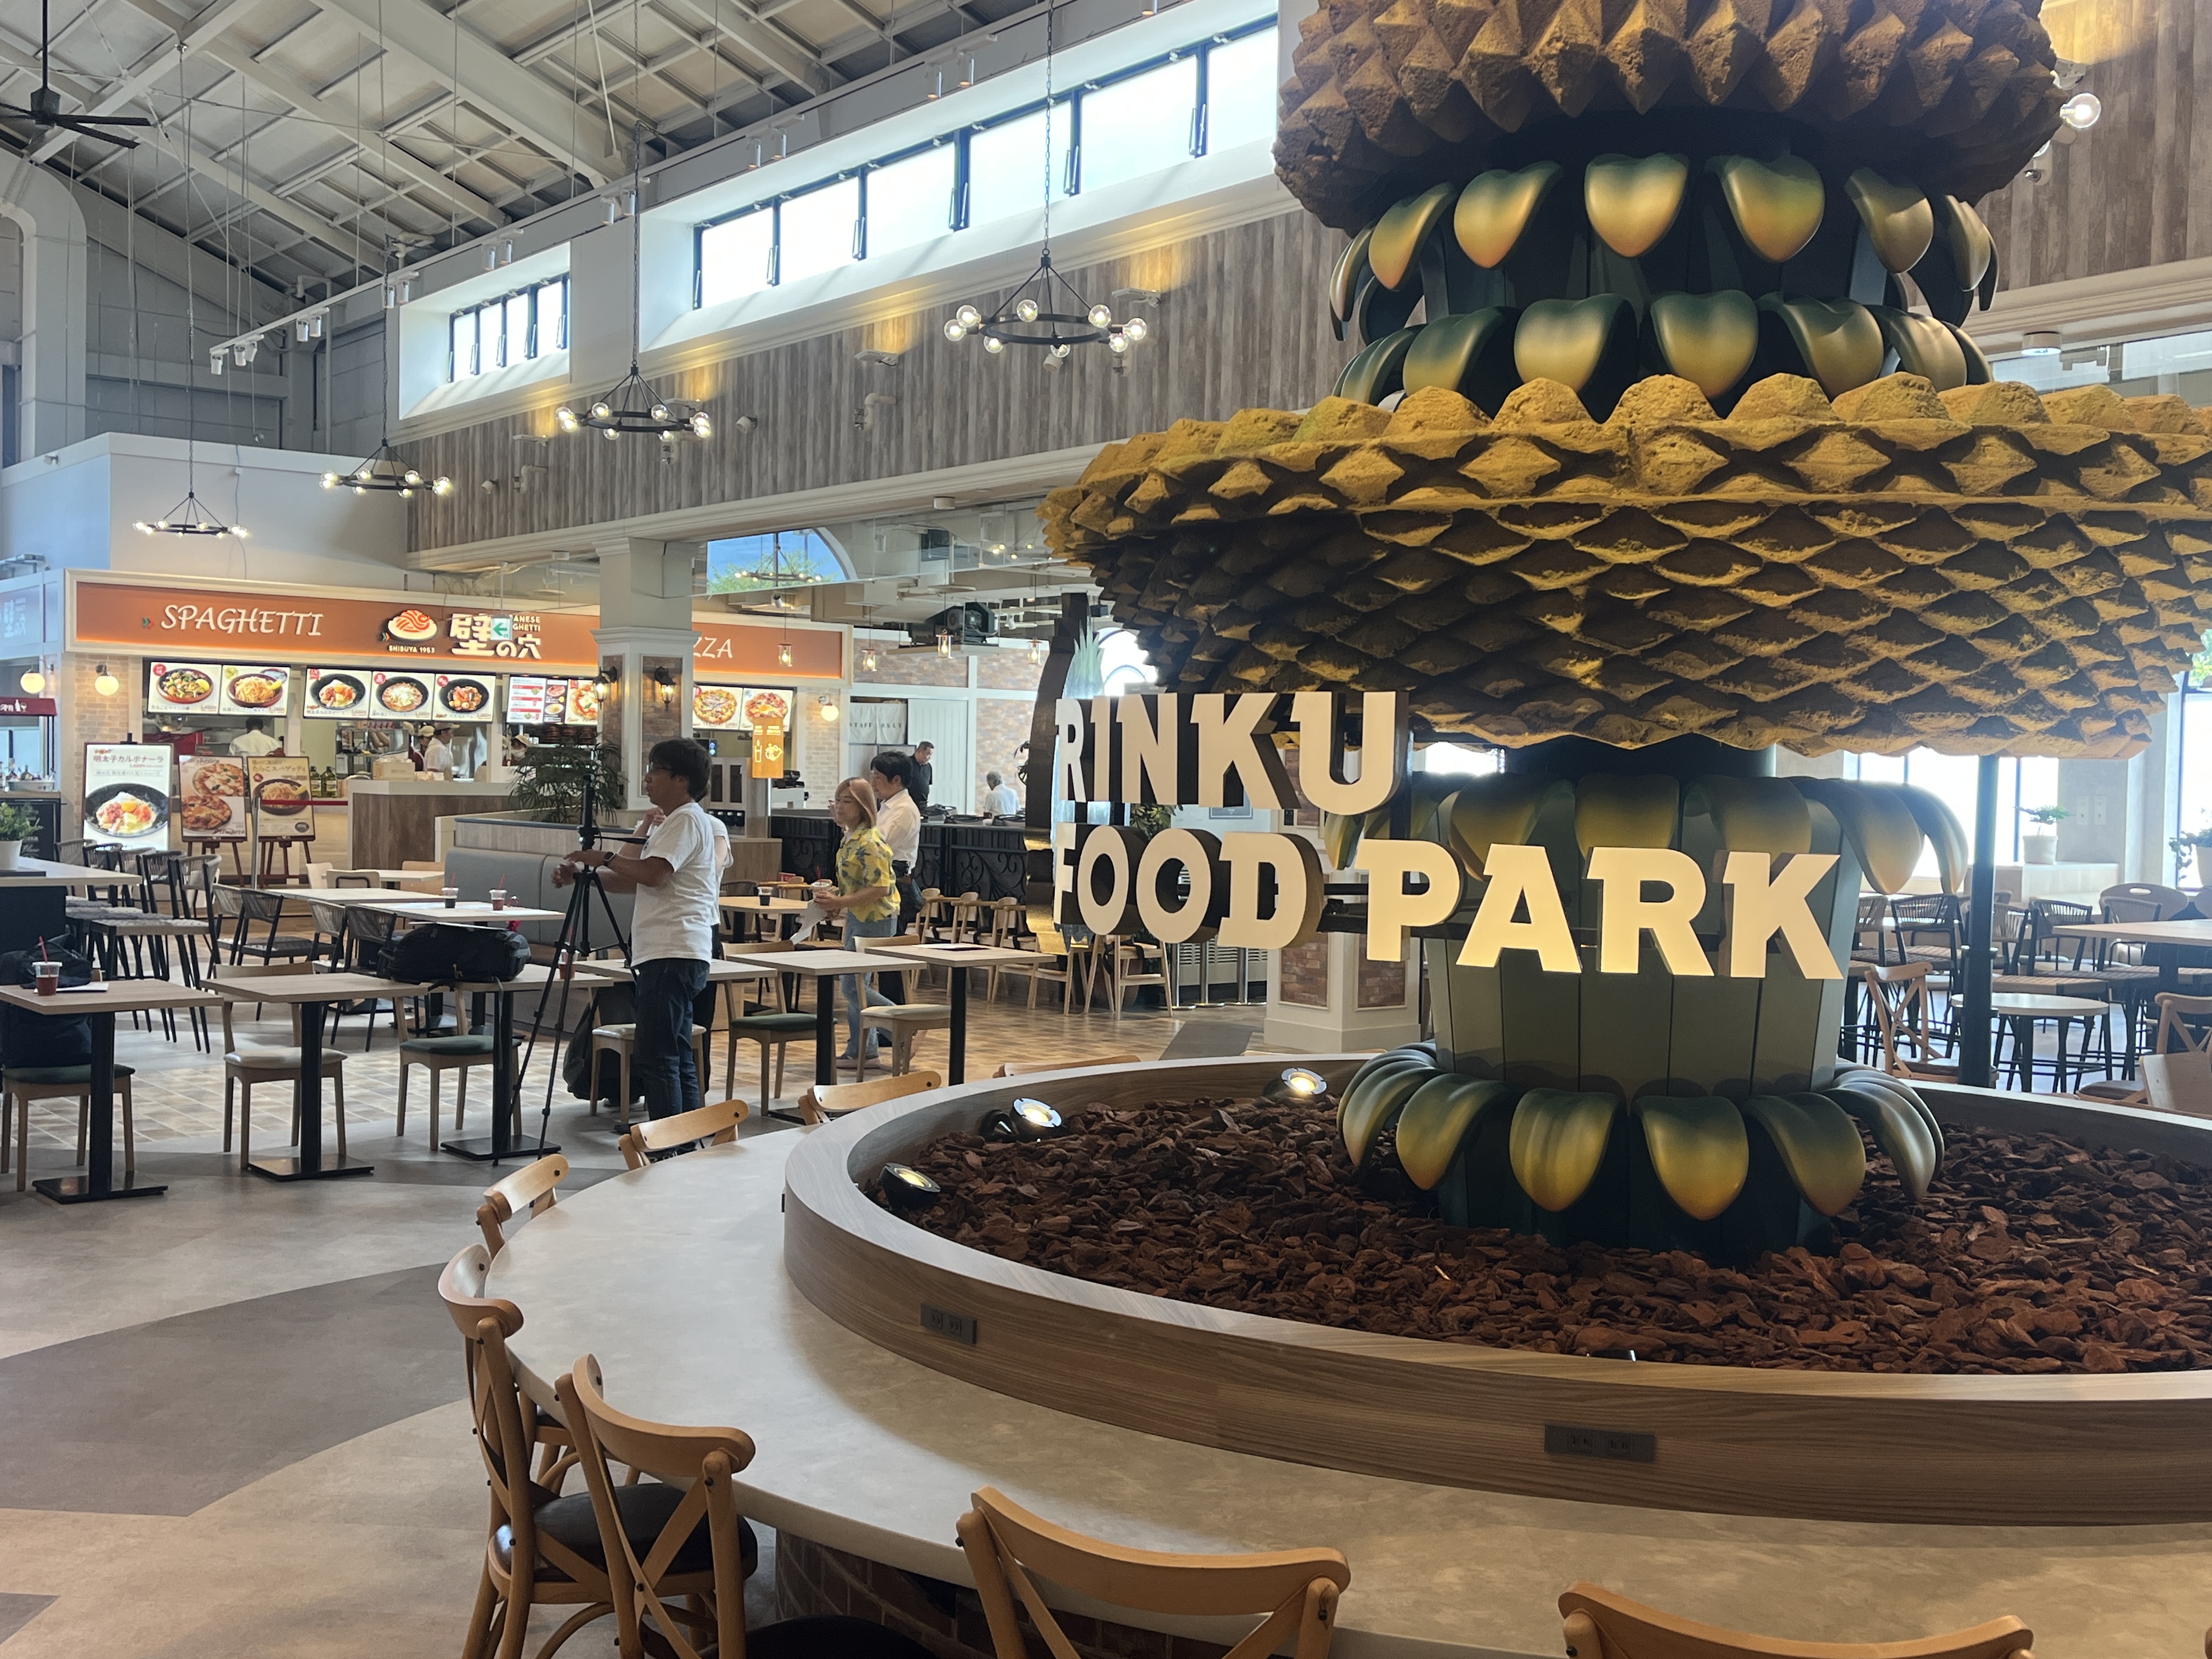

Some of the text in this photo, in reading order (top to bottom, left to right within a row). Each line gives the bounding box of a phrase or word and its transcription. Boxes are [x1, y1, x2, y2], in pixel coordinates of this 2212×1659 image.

[161, 605, 324, 636] SPAGHETTI
[509, 614, 540, 623] ANESE
[512, 623, 540, 631] GHETTI
[449, 613, 542, 659] 壁の穴
[693, 636, 733, 658] ZZA
[388, 645, 417, 653] SHIBUYA
[93, 755, 163, 763] 明太子カルボナーラ
[1056, 691, 1397, 815] RINKU
[1054, 822, 1844, 980] FOOD PARK
